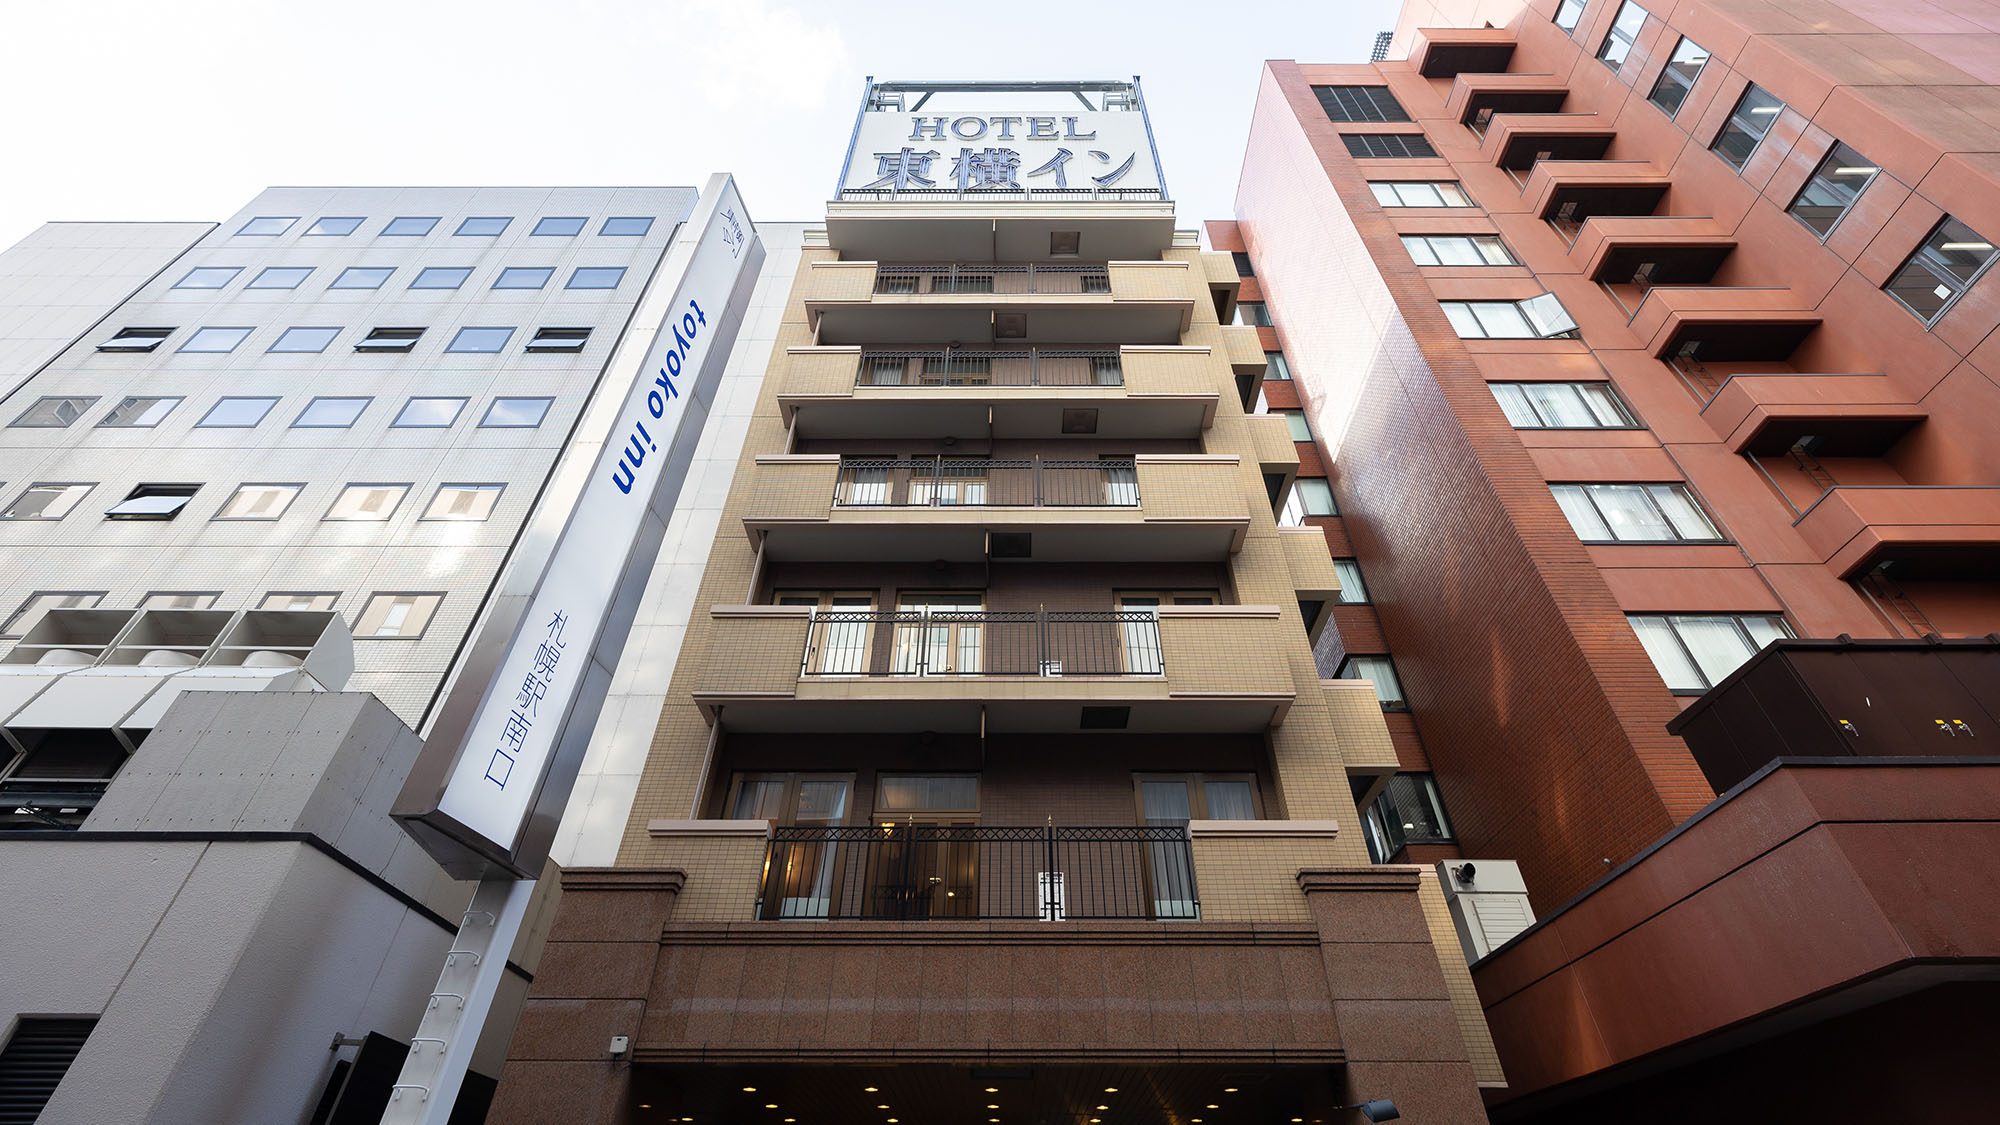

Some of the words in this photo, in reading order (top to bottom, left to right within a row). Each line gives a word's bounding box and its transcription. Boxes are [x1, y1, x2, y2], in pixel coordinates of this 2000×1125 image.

[907, 116, 1097, 141] HOTEL
[861, 147, 1136, 189] 東横イン
[647, 299, 707, 419] toyoko
[612, 420, 657, 495] inn
[484, 609, 569, 791] 札幌駅南口
